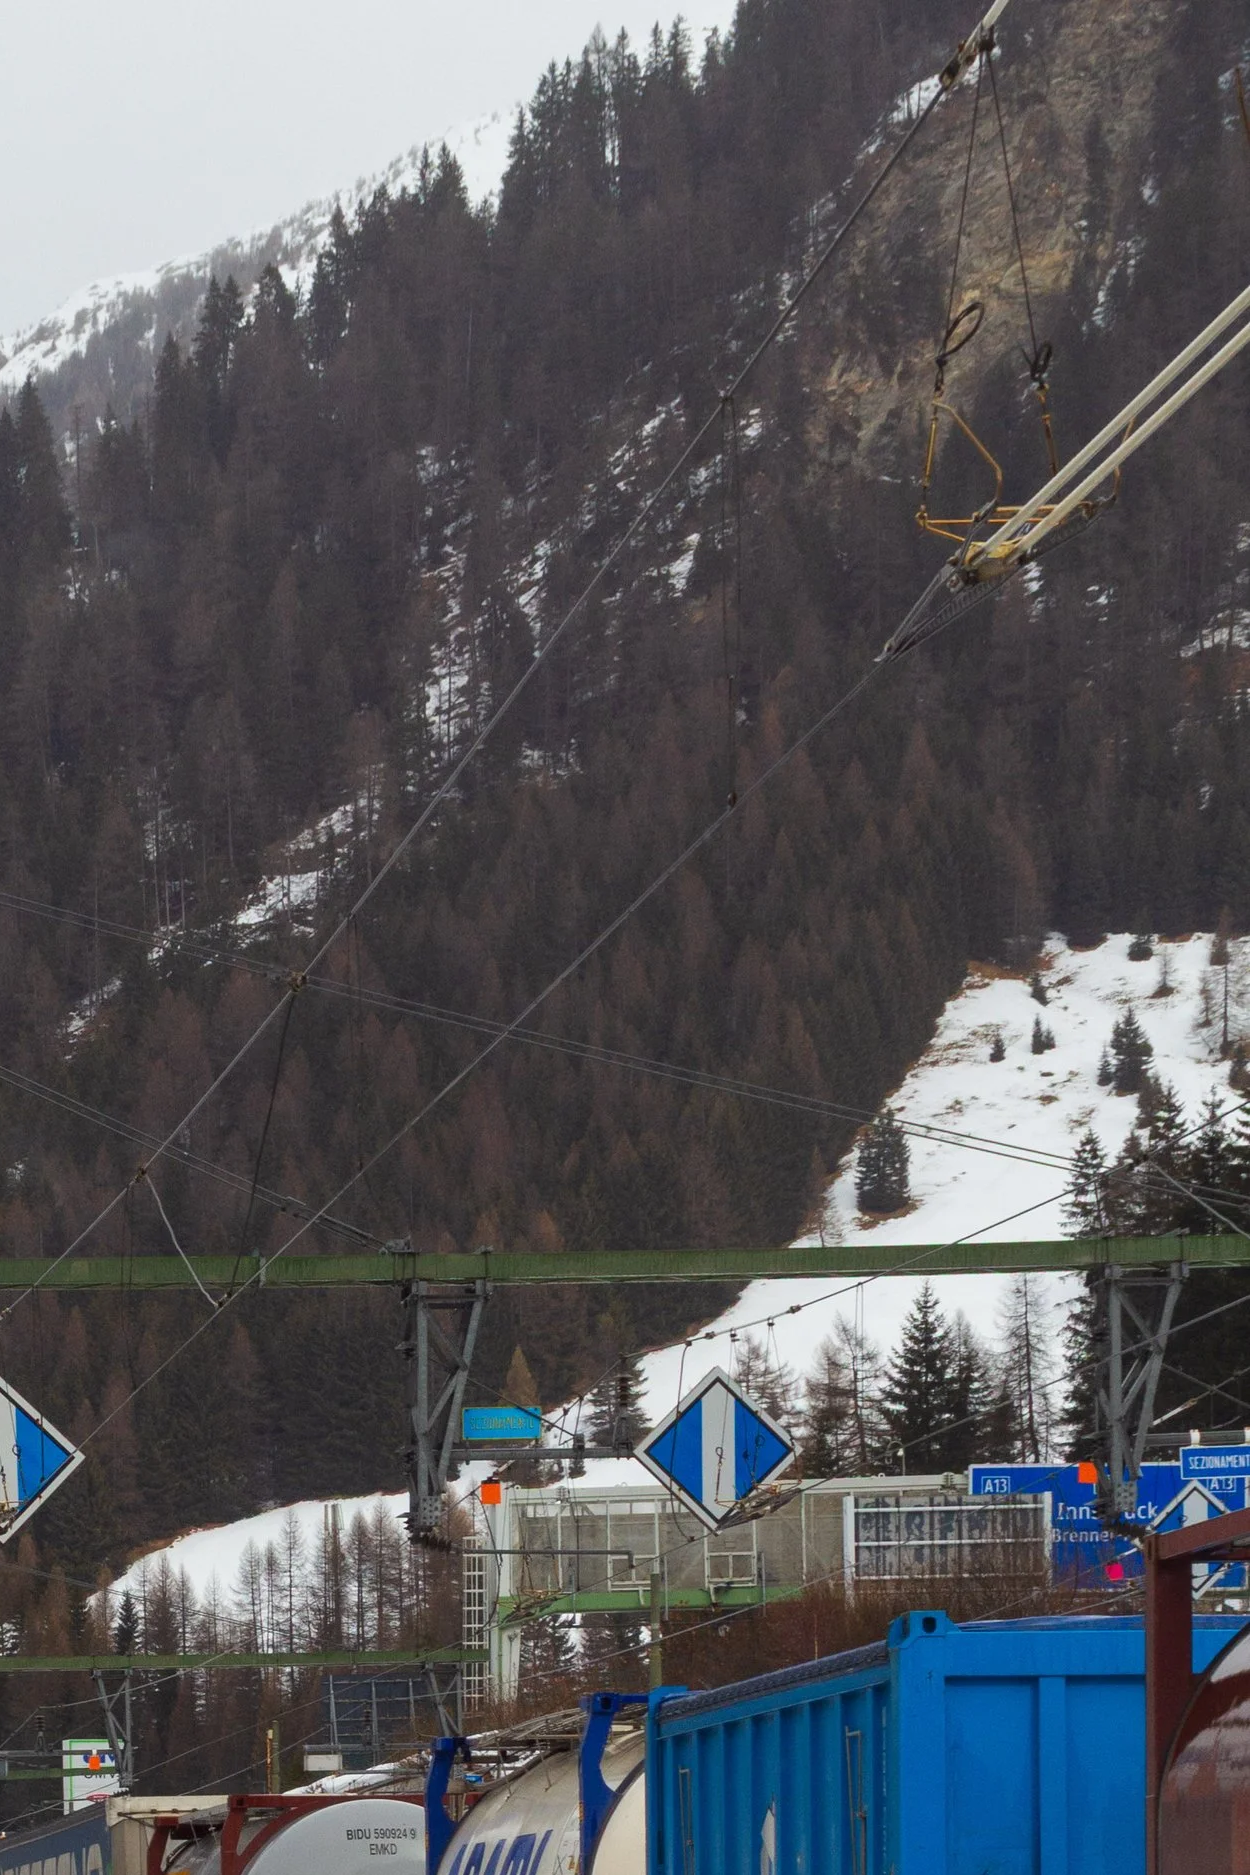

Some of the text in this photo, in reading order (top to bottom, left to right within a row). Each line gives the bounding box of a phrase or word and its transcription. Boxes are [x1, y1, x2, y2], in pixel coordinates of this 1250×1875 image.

[984, 1478, 1008, 1494] A13
[346, 1829, 371, 1841] BIDU
[374, 1828, 408, 1840] 590924
[369, 1843, 398, 1856] EMKD
